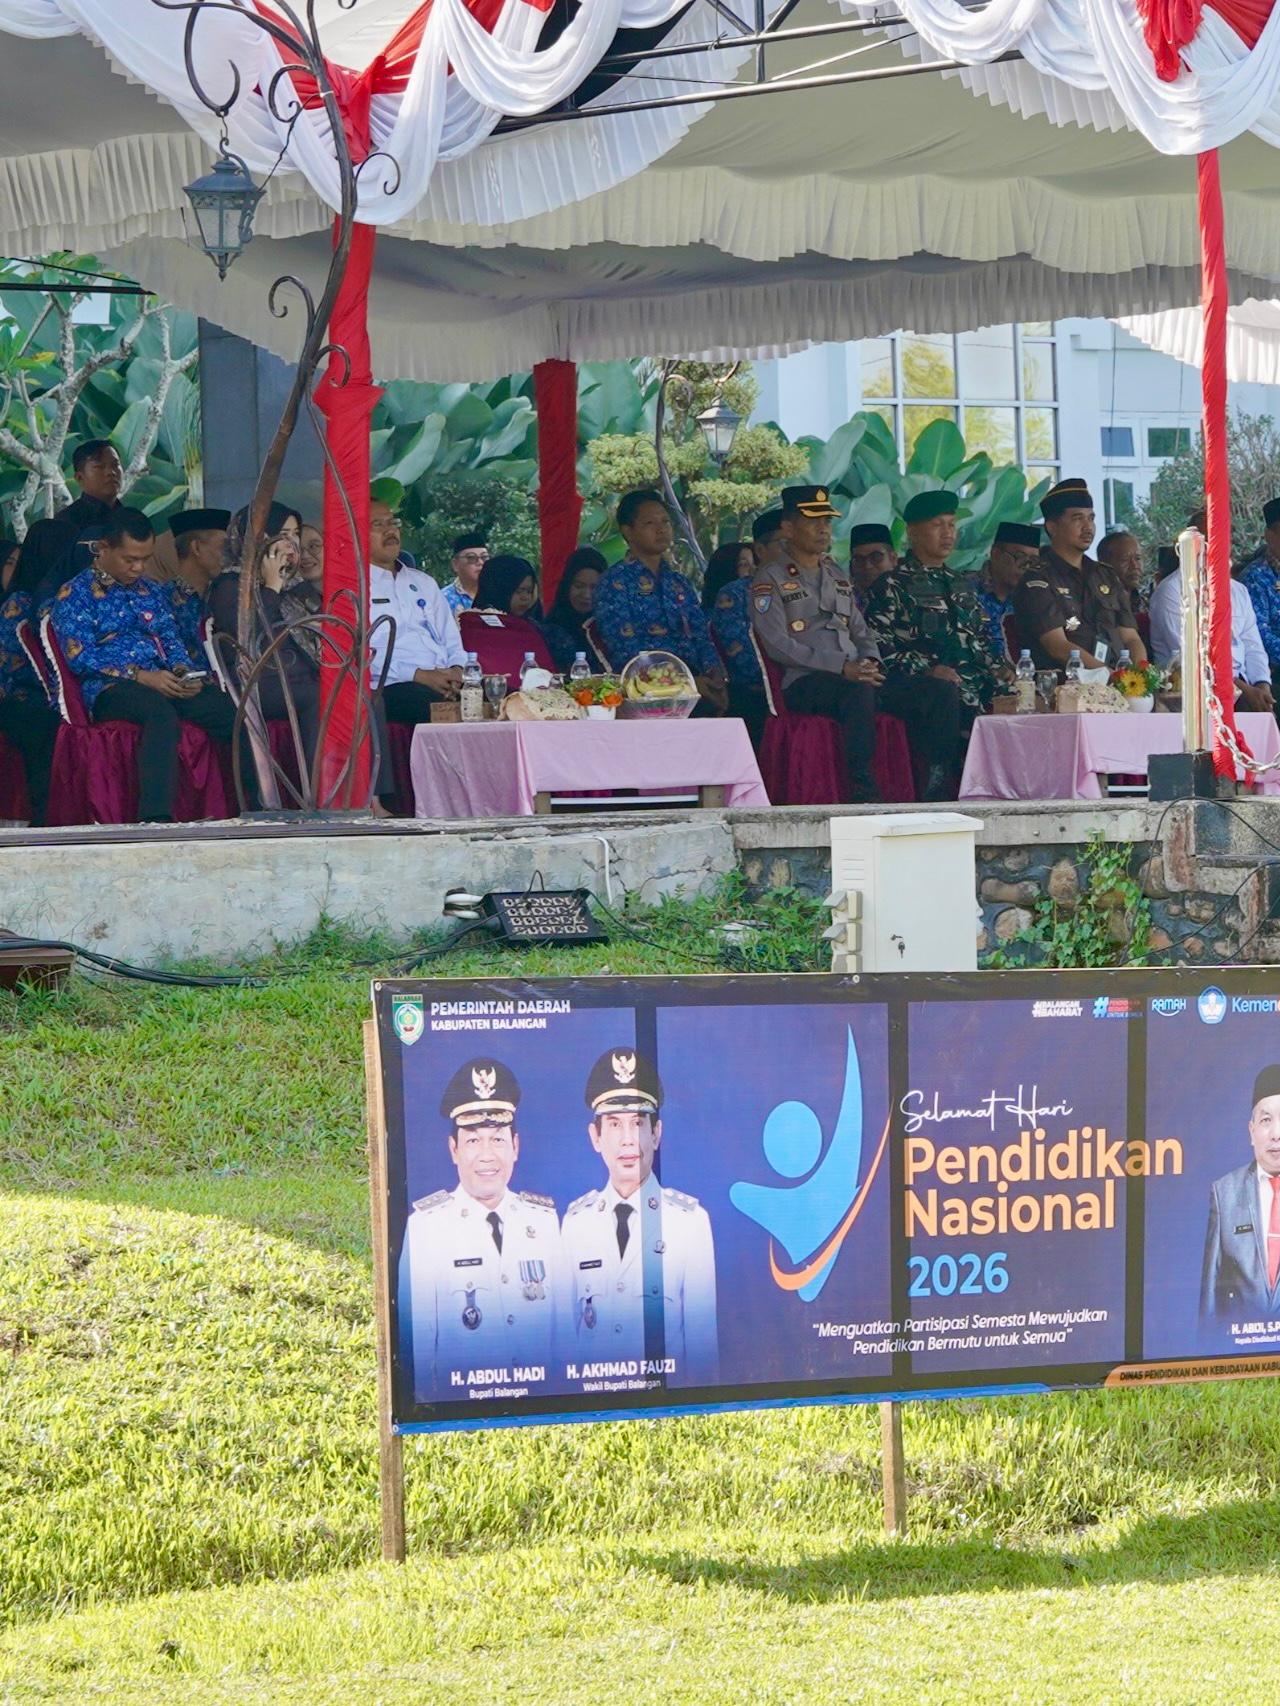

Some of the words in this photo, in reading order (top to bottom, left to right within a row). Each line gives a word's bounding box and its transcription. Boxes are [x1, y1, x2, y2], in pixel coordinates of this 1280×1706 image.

[431, 1001, 514, 1016] PEMERINTAH
[517, 1000, 571, 1015] DAERAH
[1152, 998, 1187, 1012] RAMAH
[431, 1019, 490, 1031] KABUPATEN
[492, 1018, 547, 1030] BALANGAN
[900, 1089, 1015, 1132] Selamat
[1005, 1084, 1073, 1130] Hari
[904, 1126, 1184, 1185] Pendidikan
[904, 1179, 1115, 1237] Nasional
[906, 1251, 1010, 1298] 2026
[903, 1316, 969, 1334] Partisipasi
[971, 1314, 1026, 1329] Semesta
[1028, 1309, 1108, 1327] Mewujudkan
[853, 1338, 925, 1355] Pendidikan
[927, 1334, 982, 1351] Bermutu
[984, 1332, 1020, 1348] untuk
[451, 1370, 465, 1386] H.
[467, 1368, 512, 1385] ABDUL
[513, 1366, 545, 1382] HADI
[566, 1364, 580, 1380] H.
[582, 1361, 637, 1378] AKHMAD
[641, 1358, 676, 1375] FAUZI
[1119, 1371, 1144, 1381] DINAS
[1145, 1368, 1191, 1380] PENDIDIKAN
[1192, 1367, 1209, 1377] DAN
[1210, 1363, 1261, 1376] KEBUDAYAAN
[469, 1388, 494, 1400] Bupati
[494, 1387, 529, 1399] Balangan
[583, 1381, 603, 1392] Wakil
[603, 1380, 627, 1392] Bupati
[628, 1379, 662, 1391] Balangan
